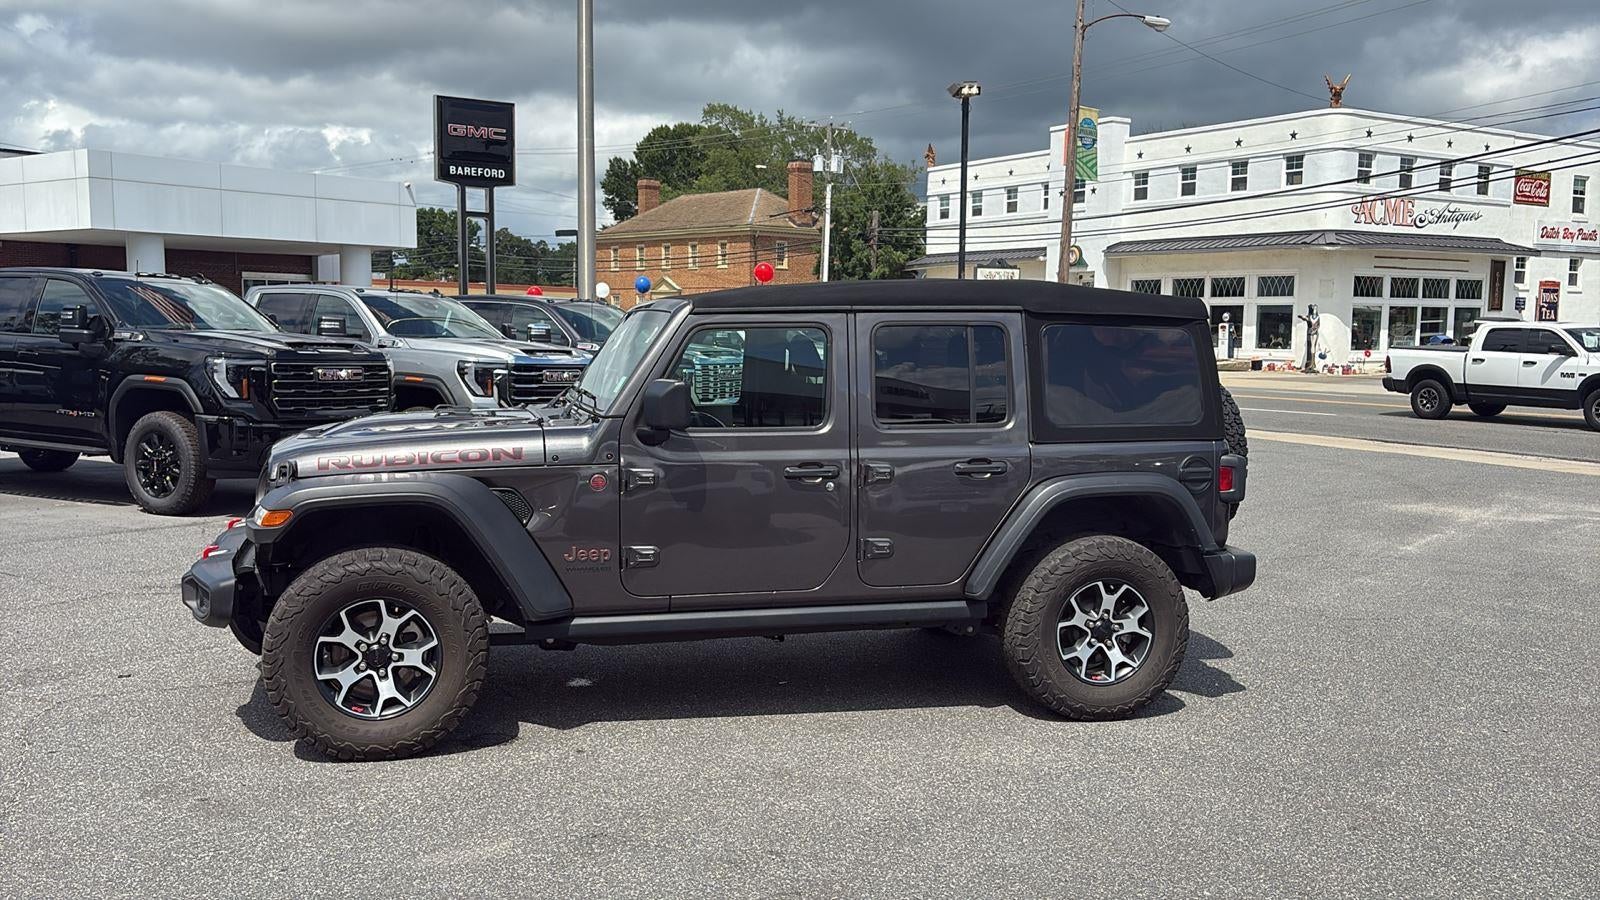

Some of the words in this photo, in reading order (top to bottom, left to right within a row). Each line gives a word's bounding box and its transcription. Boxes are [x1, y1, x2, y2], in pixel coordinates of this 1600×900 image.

[447, 123, 507, 140] GMC
[449, 165, 505, 178] BAREFORD
[1351, 196, 1416, 227] ACME
[1414, 200, 1483, 230] Antiques
[1540, 226, 1560, 239] Dutch
[1562, 227, 1576, 243] Boy
[1576, 228, 1598, 241] Paints
[1540, 289, 1558, 307] LYONS
[1541, 307, 1556, 320] TEA
[318, 369, 362, 380] GMC
[317, 447, 523, 471] RUBICON
[563, 546, 611, 563] Jeep
